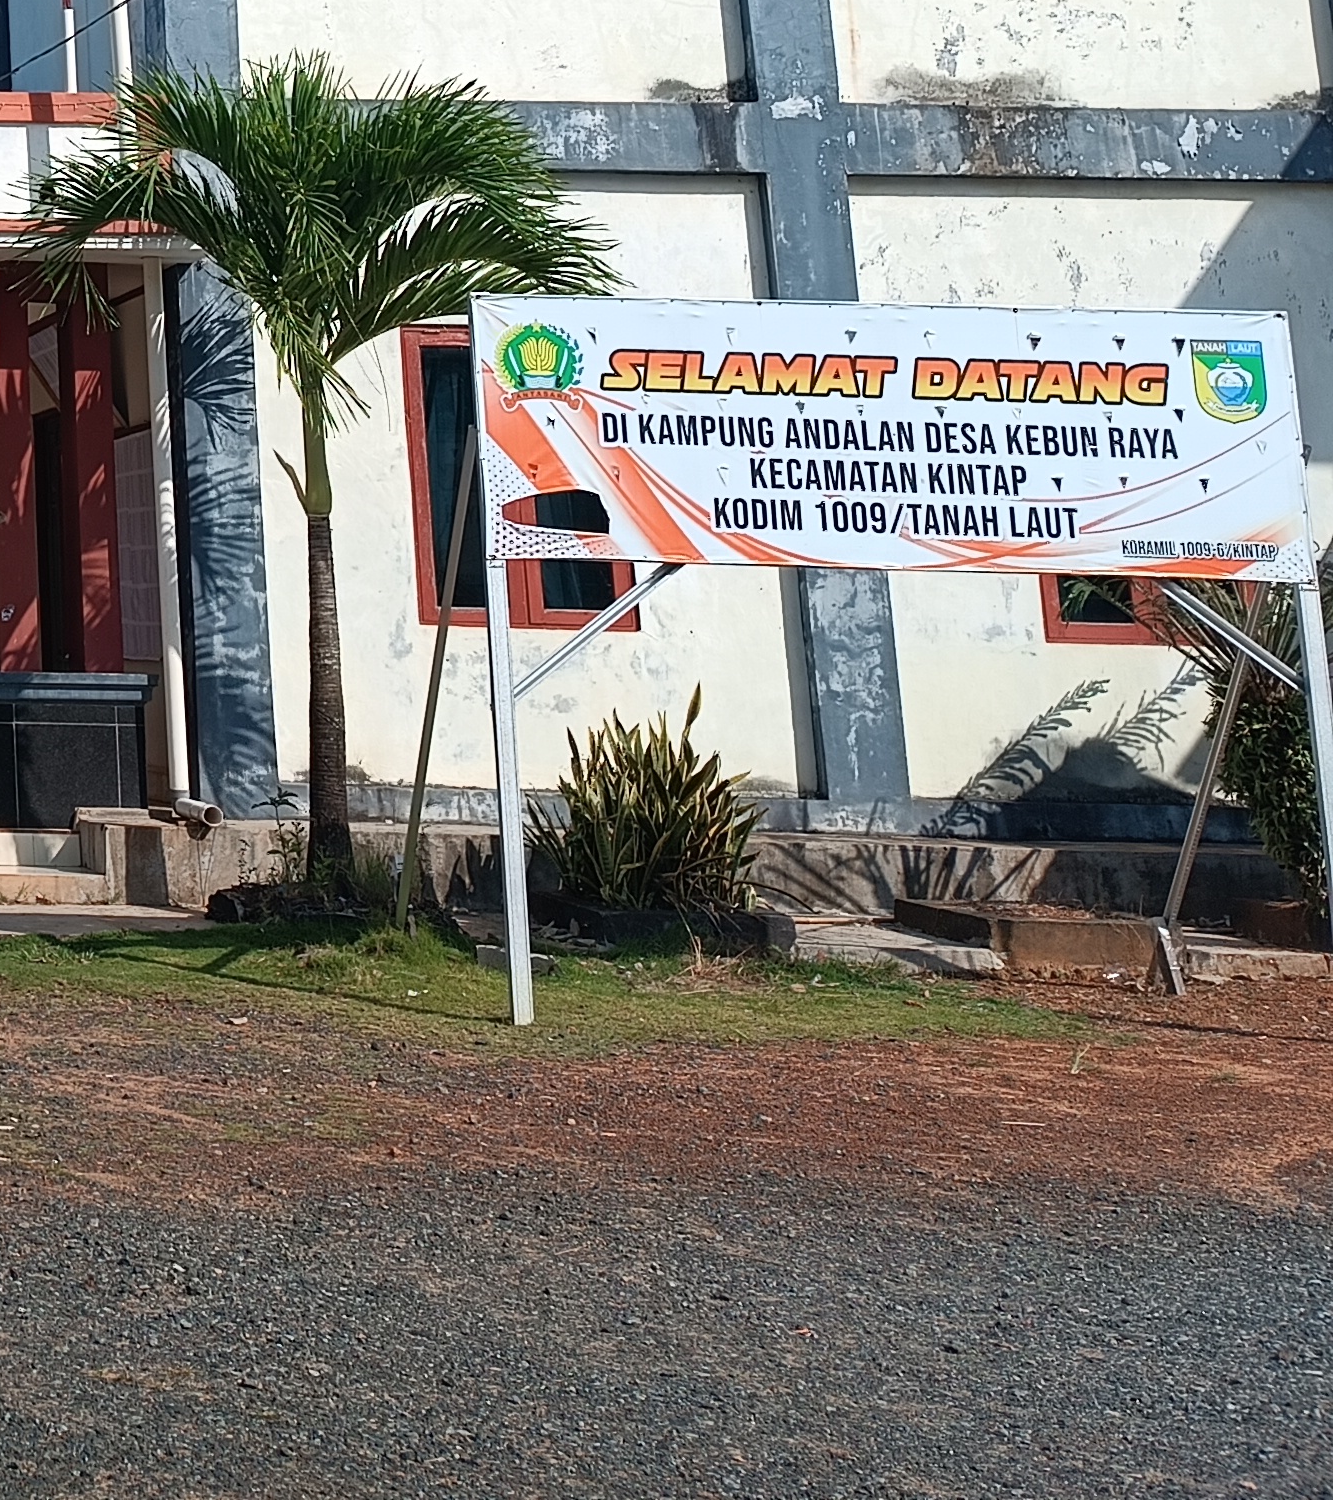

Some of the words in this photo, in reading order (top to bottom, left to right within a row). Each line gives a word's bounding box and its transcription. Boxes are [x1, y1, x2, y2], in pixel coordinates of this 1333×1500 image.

[1192, 341, 1226, 353] TANAH
[1230, 342, 1258, 353] LAUT
[600, 349, 898, 399] SELAMAT
[912, 357, 1169, 406] DATANG
[602, 412, 629, 444] DI
[638, 413, 774, 449] KAMPUNG
[785, 418, 915, 452] ANDALAN
[924, 422, 997, 455] DESA
[1005, 423, 1099, 458] KEBUN
[1108, 426, 1179, 460] RAYA
[749, 457, 916, 493] KECAMATAN
[927, 463, 1027, 497] KINTAP
[713, 497, 803, 531] KODIM
[815, 501, 1000, 537] 1009/TANAH
[1009, 505, 1078, 539] LAUT
[1121, 540, 1177, 556] KORAMIL
